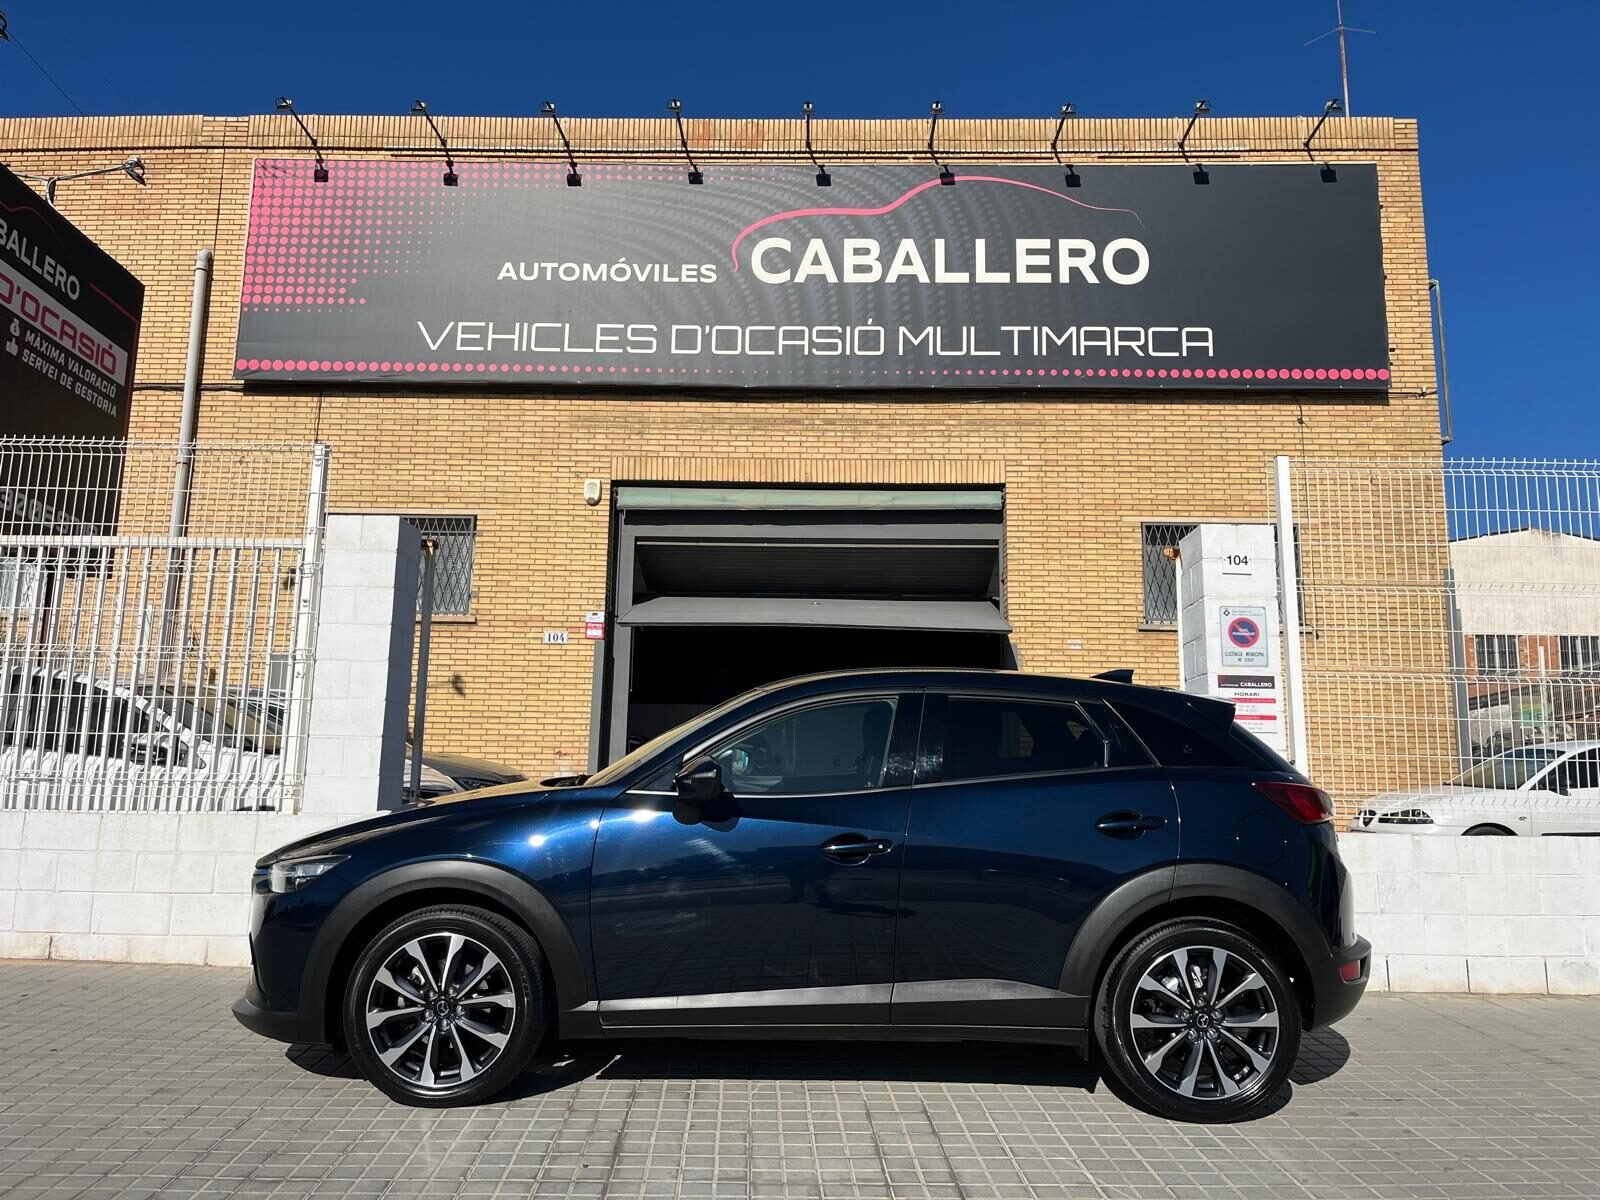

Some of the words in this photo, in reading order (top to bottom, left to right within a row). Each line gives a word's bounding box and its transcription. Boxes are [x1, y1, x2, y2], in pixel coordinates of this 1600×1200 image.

[497, 257, 718, 283] AUTOMÓVILES
[750, 237, 1150, 285] CABALLERO
[417, 321, 657, 354] VEHICLES
[671, 317, 885, 356] D'OCASIÓ
[898, 325, 1214, 357] MULTIMARCA
[22, 348, 58, 381] SERVEI
[60, 372, 73, 390] DE
[75, 382, 117, 418] GESTORIA
[67, 356, 117, 399] VALORACIÓ
[1226, 554, 1249, 566] 104
[547, 633, 565, 643] 104
